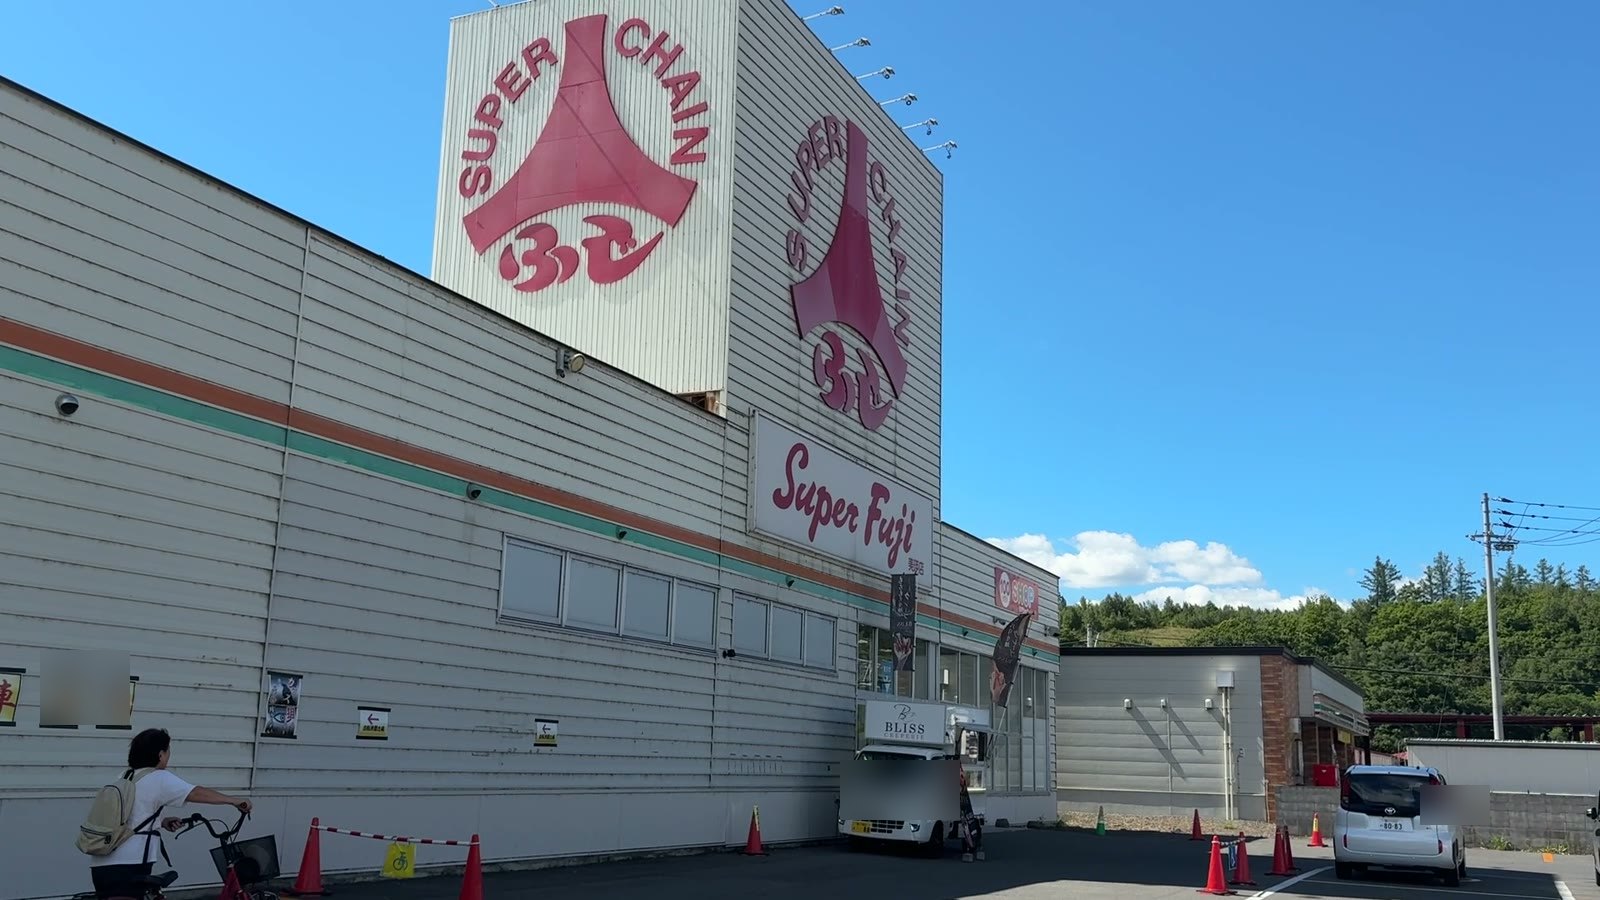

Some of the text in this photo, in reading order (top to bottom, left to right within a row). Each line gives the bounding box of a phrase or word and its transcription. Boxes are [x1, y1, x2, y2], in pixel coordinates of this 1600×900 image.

[458, 18, 709, 199] SUPER CHAIN
[786, 115, 911, 347] SUPER CHAIN
[772, 442, 916, 569] Super Fuji
[885, 721, 925, 735] BLISS
